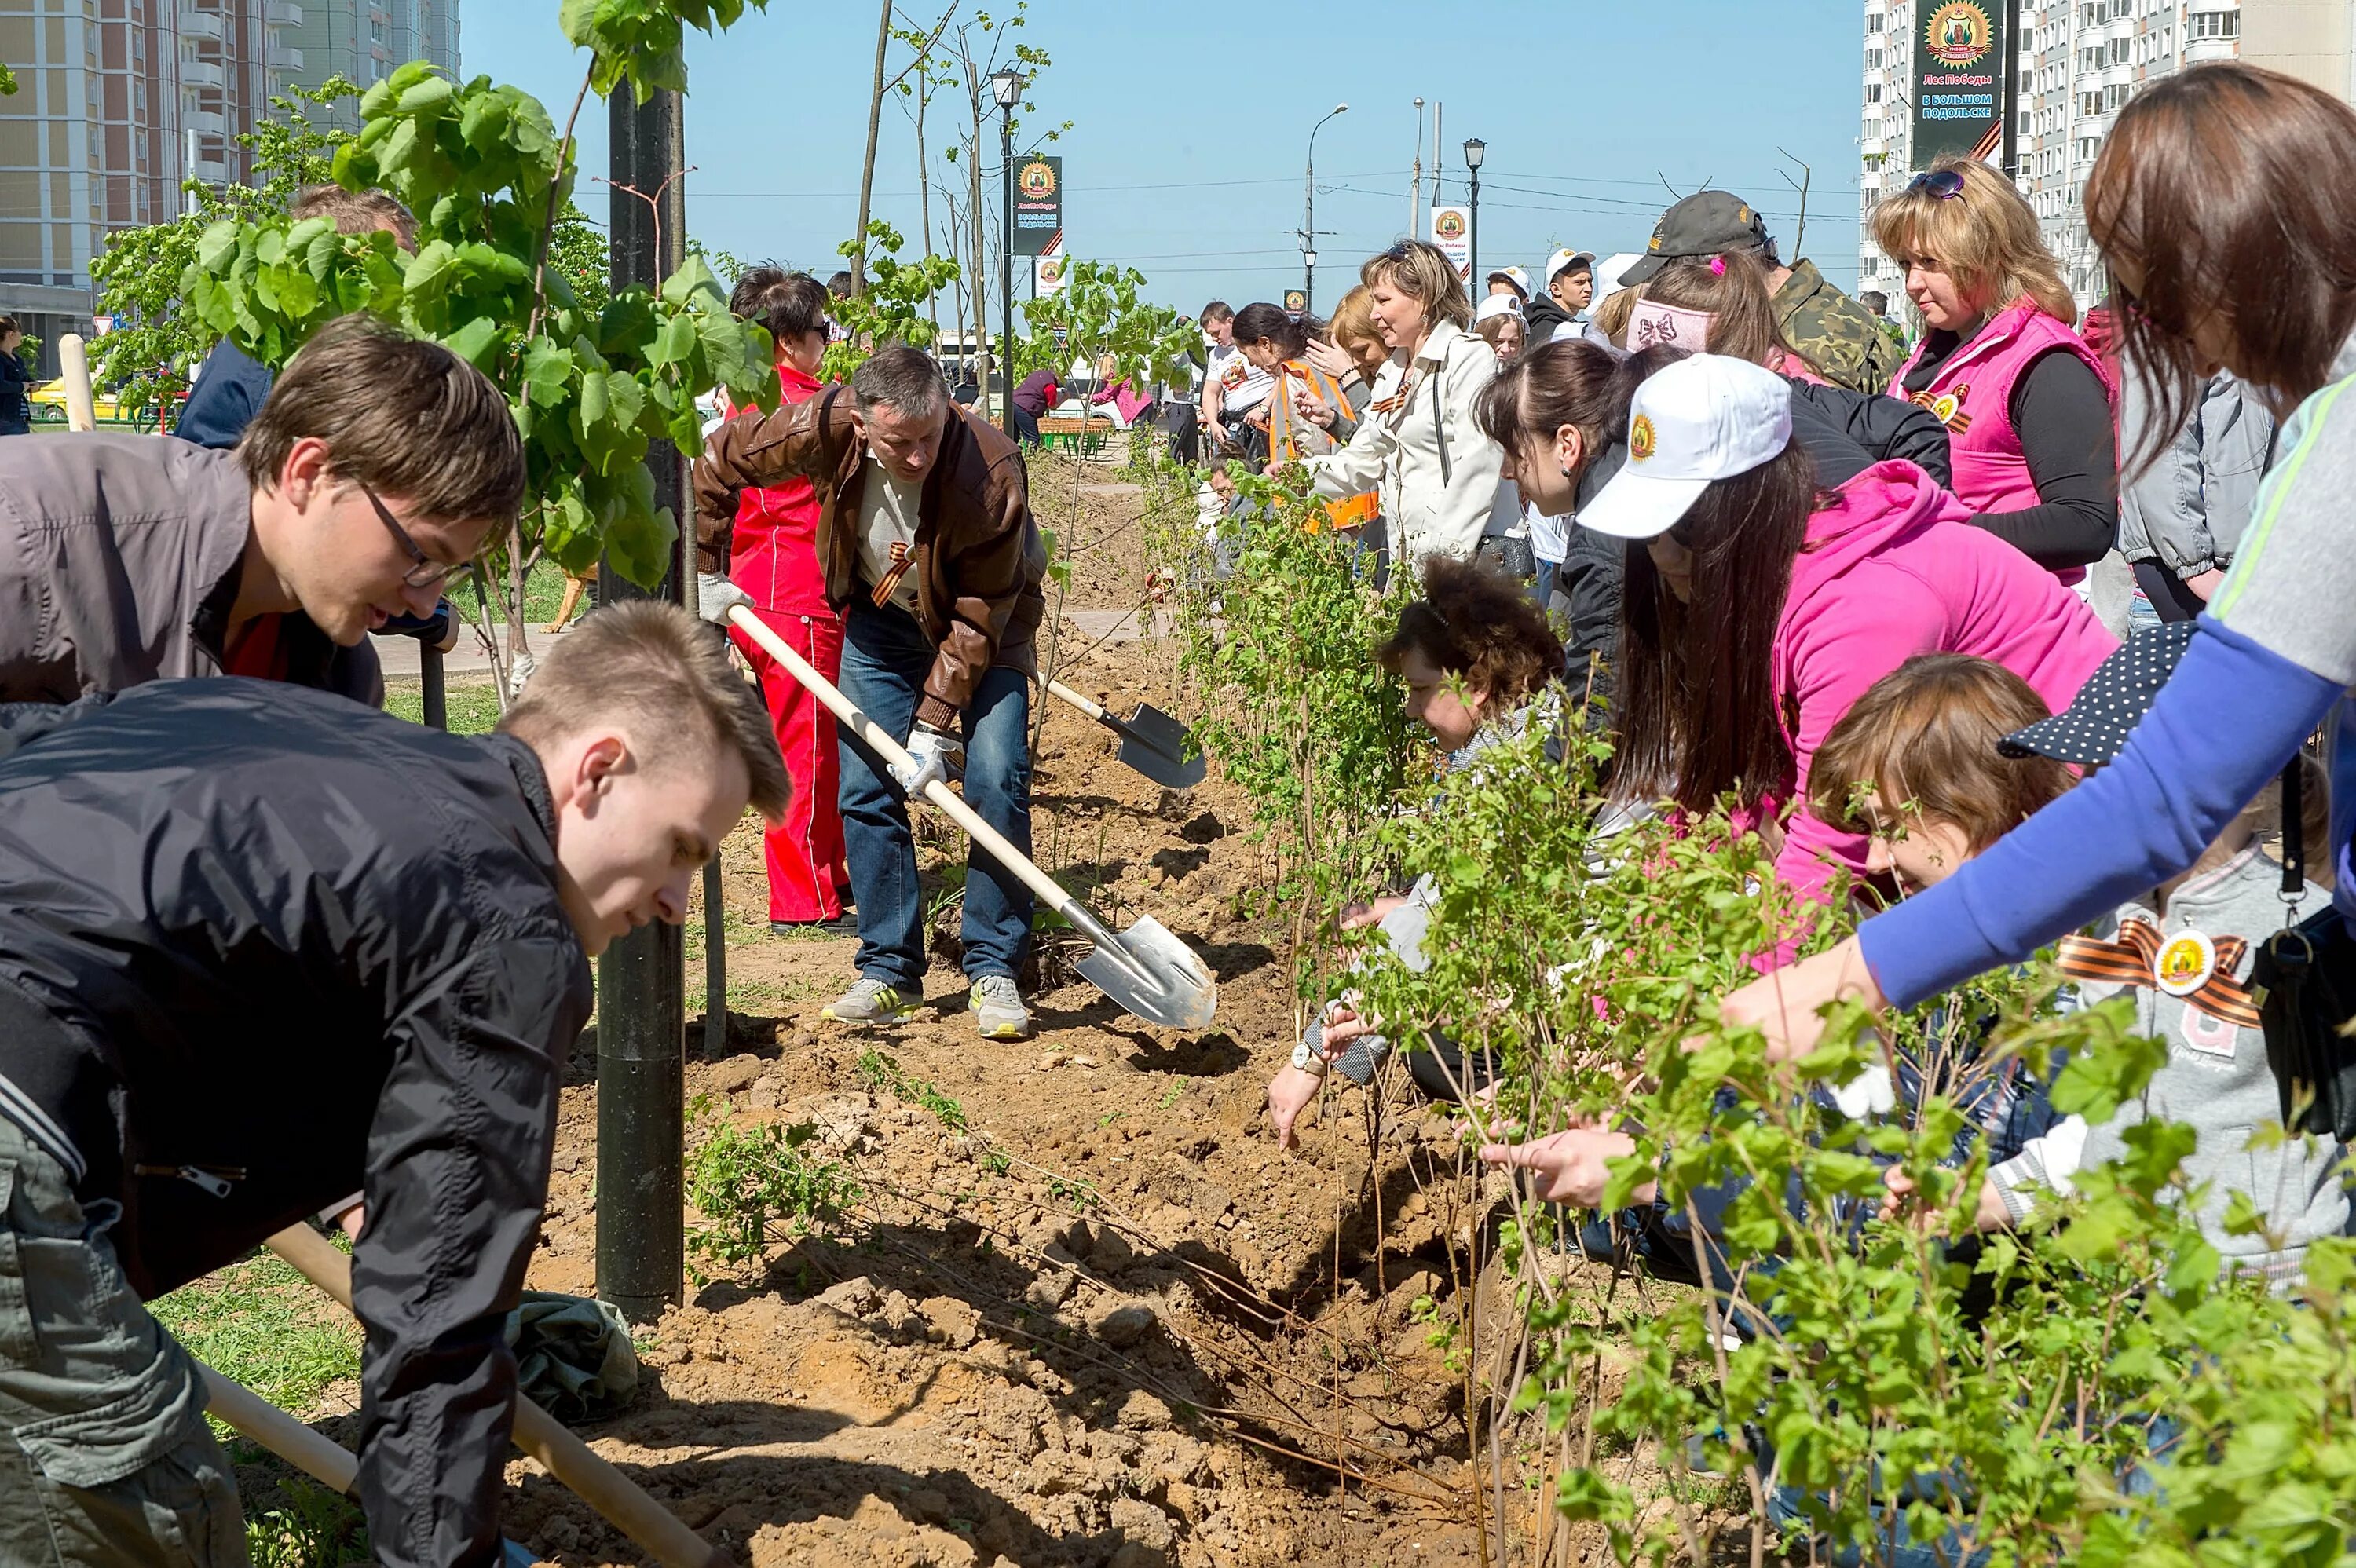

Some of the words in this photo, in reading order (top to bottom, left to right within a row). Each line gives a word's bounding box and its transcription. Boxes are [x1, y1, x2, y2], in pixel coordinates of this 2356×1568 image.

[1923, 74, 1944, 85] Лес
[1945, 74, 1992, 86] Победы
[1922, 95, 1930, 105] В
[1932, 94, 1992, 105] БОЛЬШОМ
[1922, 107, 1991, 120] ПОДОЛЬСКЕ
[1030, 202, 1057, 210] Победы
